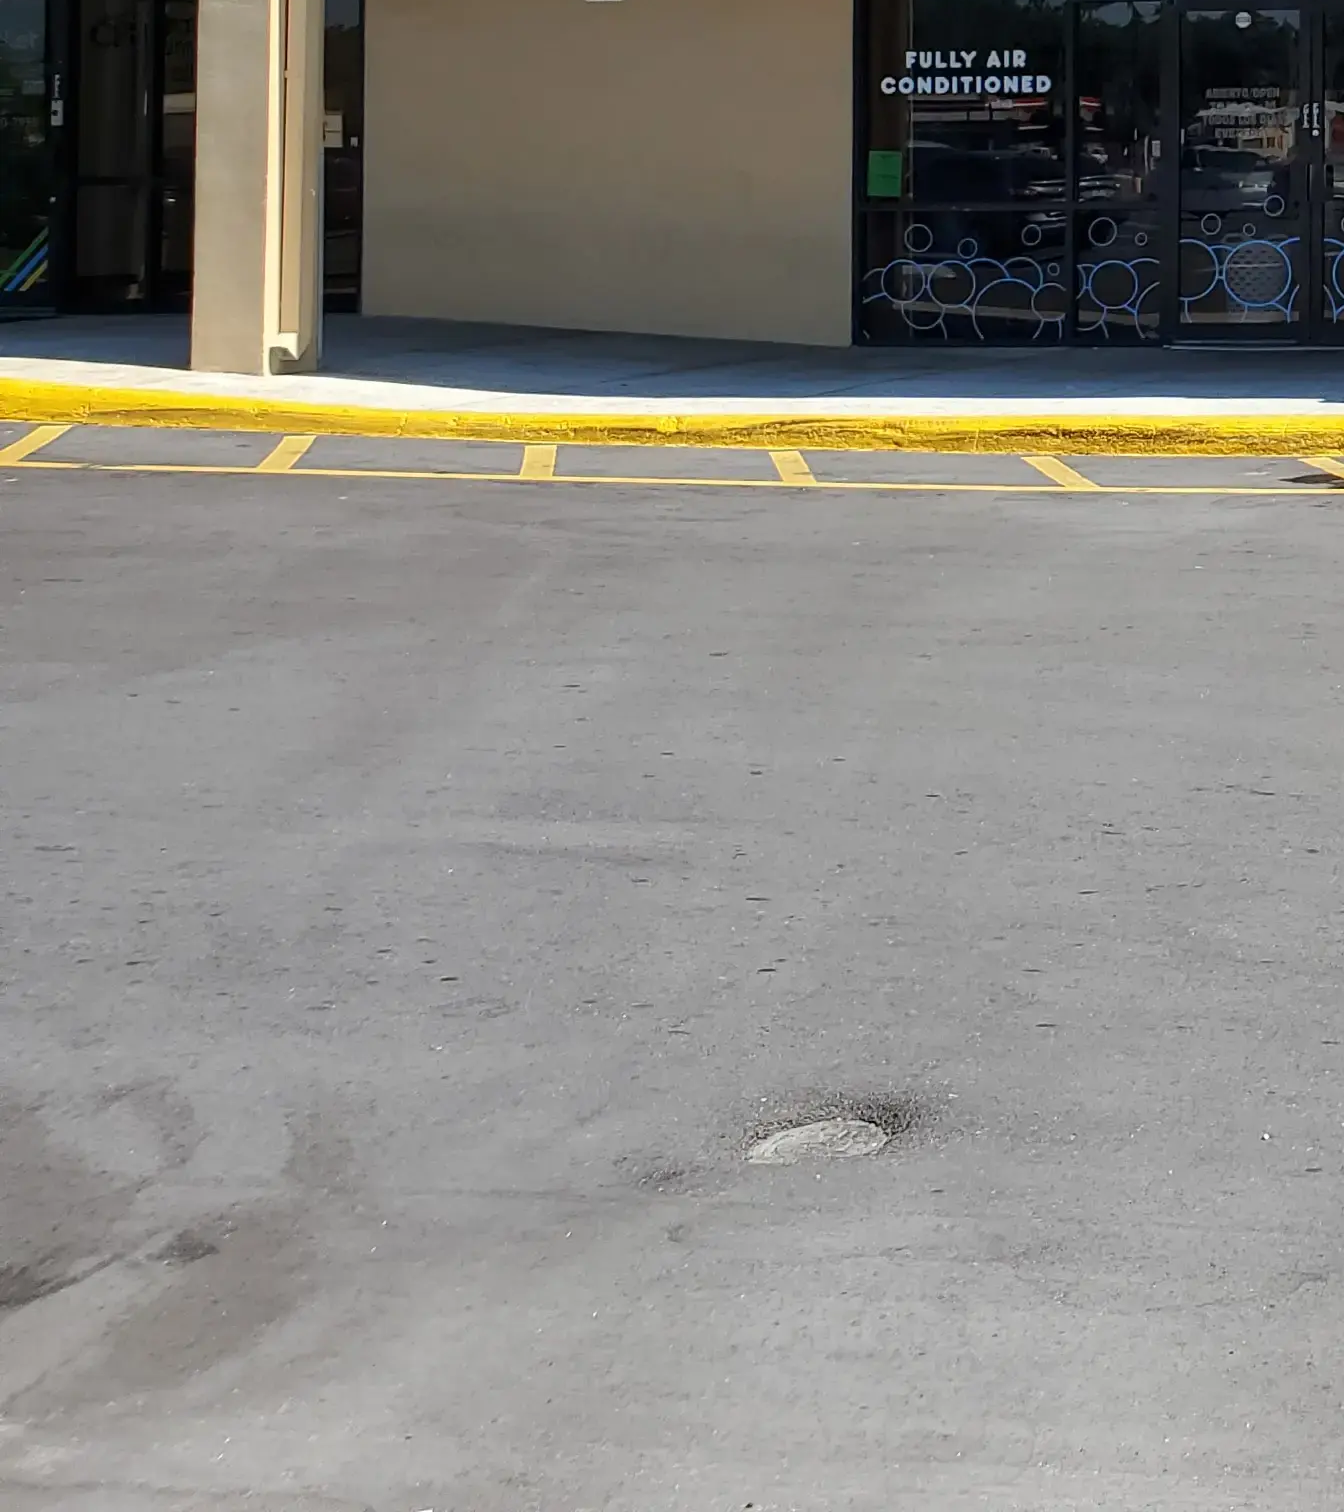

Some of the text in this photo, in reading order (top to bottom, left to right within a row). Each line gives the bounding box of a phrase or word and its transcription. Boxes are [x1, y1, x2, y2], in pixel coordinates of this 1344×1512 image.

[905, 50, 1027, 69] FULLY AIR
[881, 75, 1051, 94] CONDITIONED
